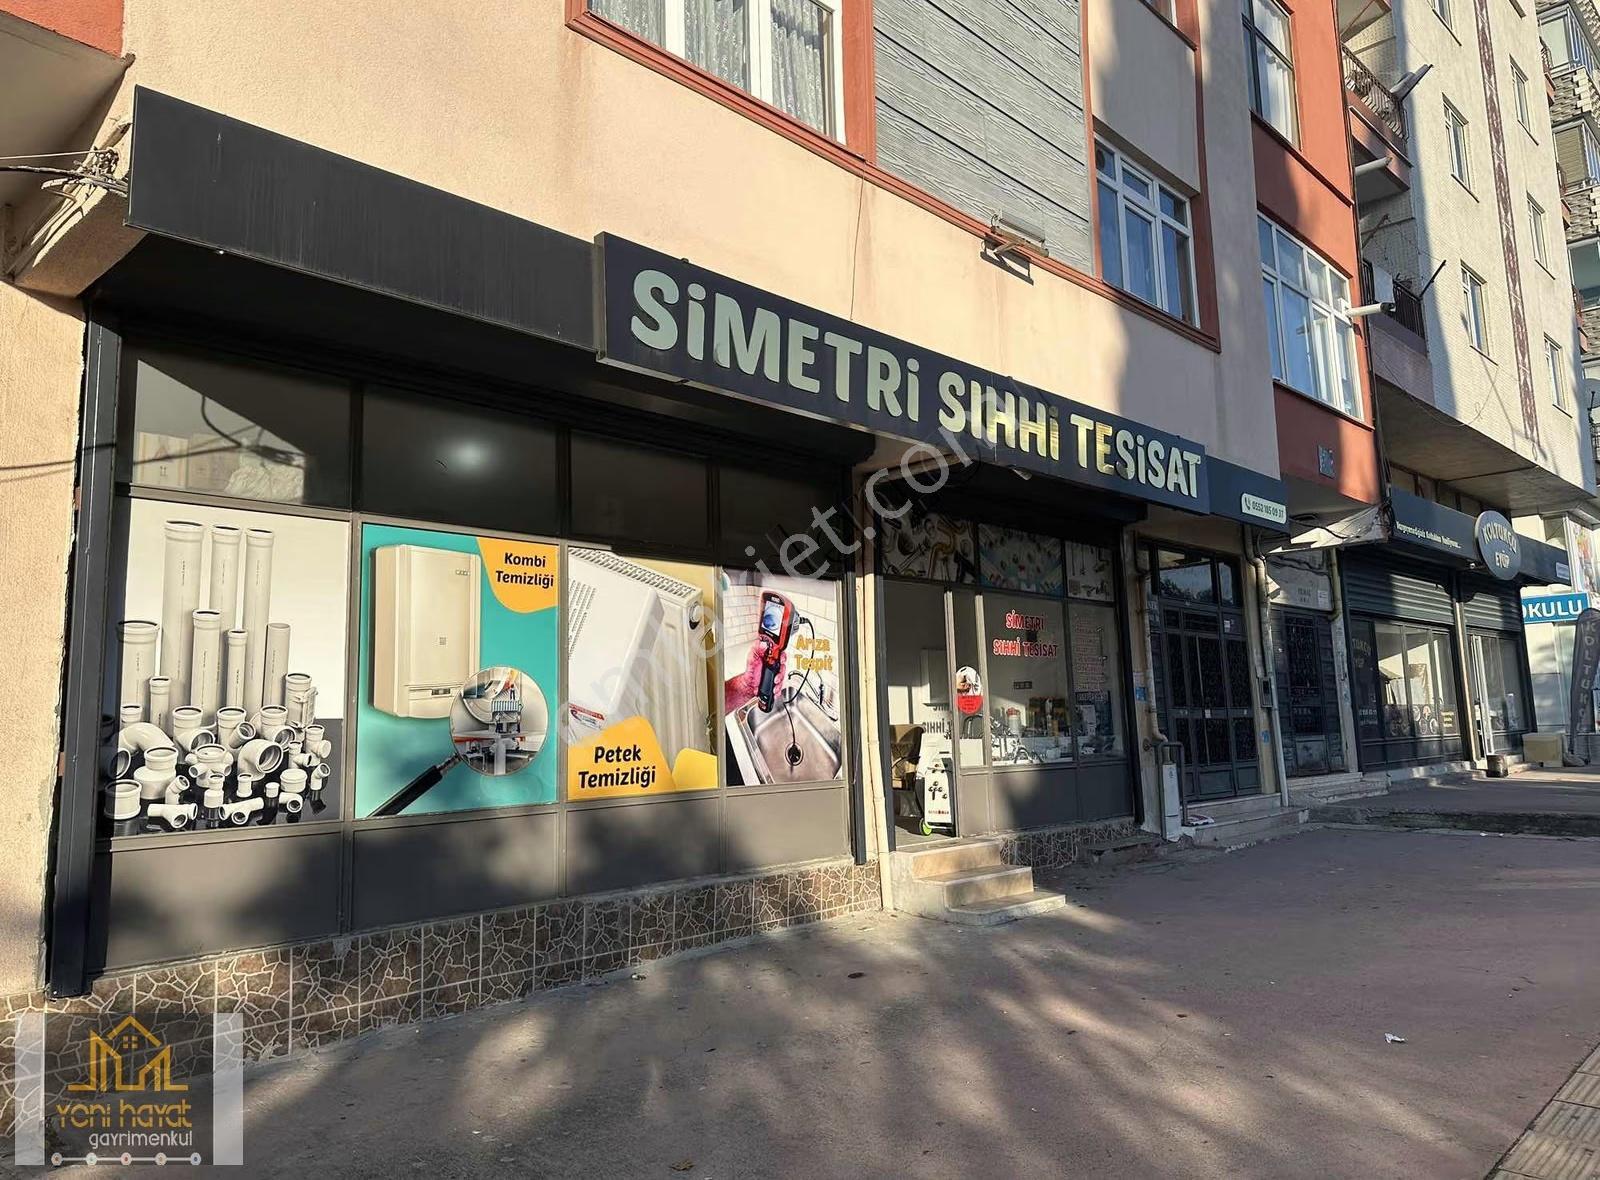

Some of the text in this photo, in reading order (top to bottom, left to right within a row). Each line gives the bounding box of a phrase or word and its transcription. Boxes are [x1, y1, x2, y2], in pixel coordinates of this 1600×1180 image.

[630, 268, 1202, 499] SİMETRİ SIHHİ TESİSAT
[503, 551, 548, 568] Kombi
[495, 569, 555, 590] Temizliği
[1005, 609, 1045, 631] SİMETRİ
[795, 634, 831, 652] Arıza
[992, 636, 1059, 657] SIHHİ TESİSAT
[794, 653, 833, 673] Tespit
[593, 744, 642, 764] Petek
[578, 765, 656, 789] Temizliği
